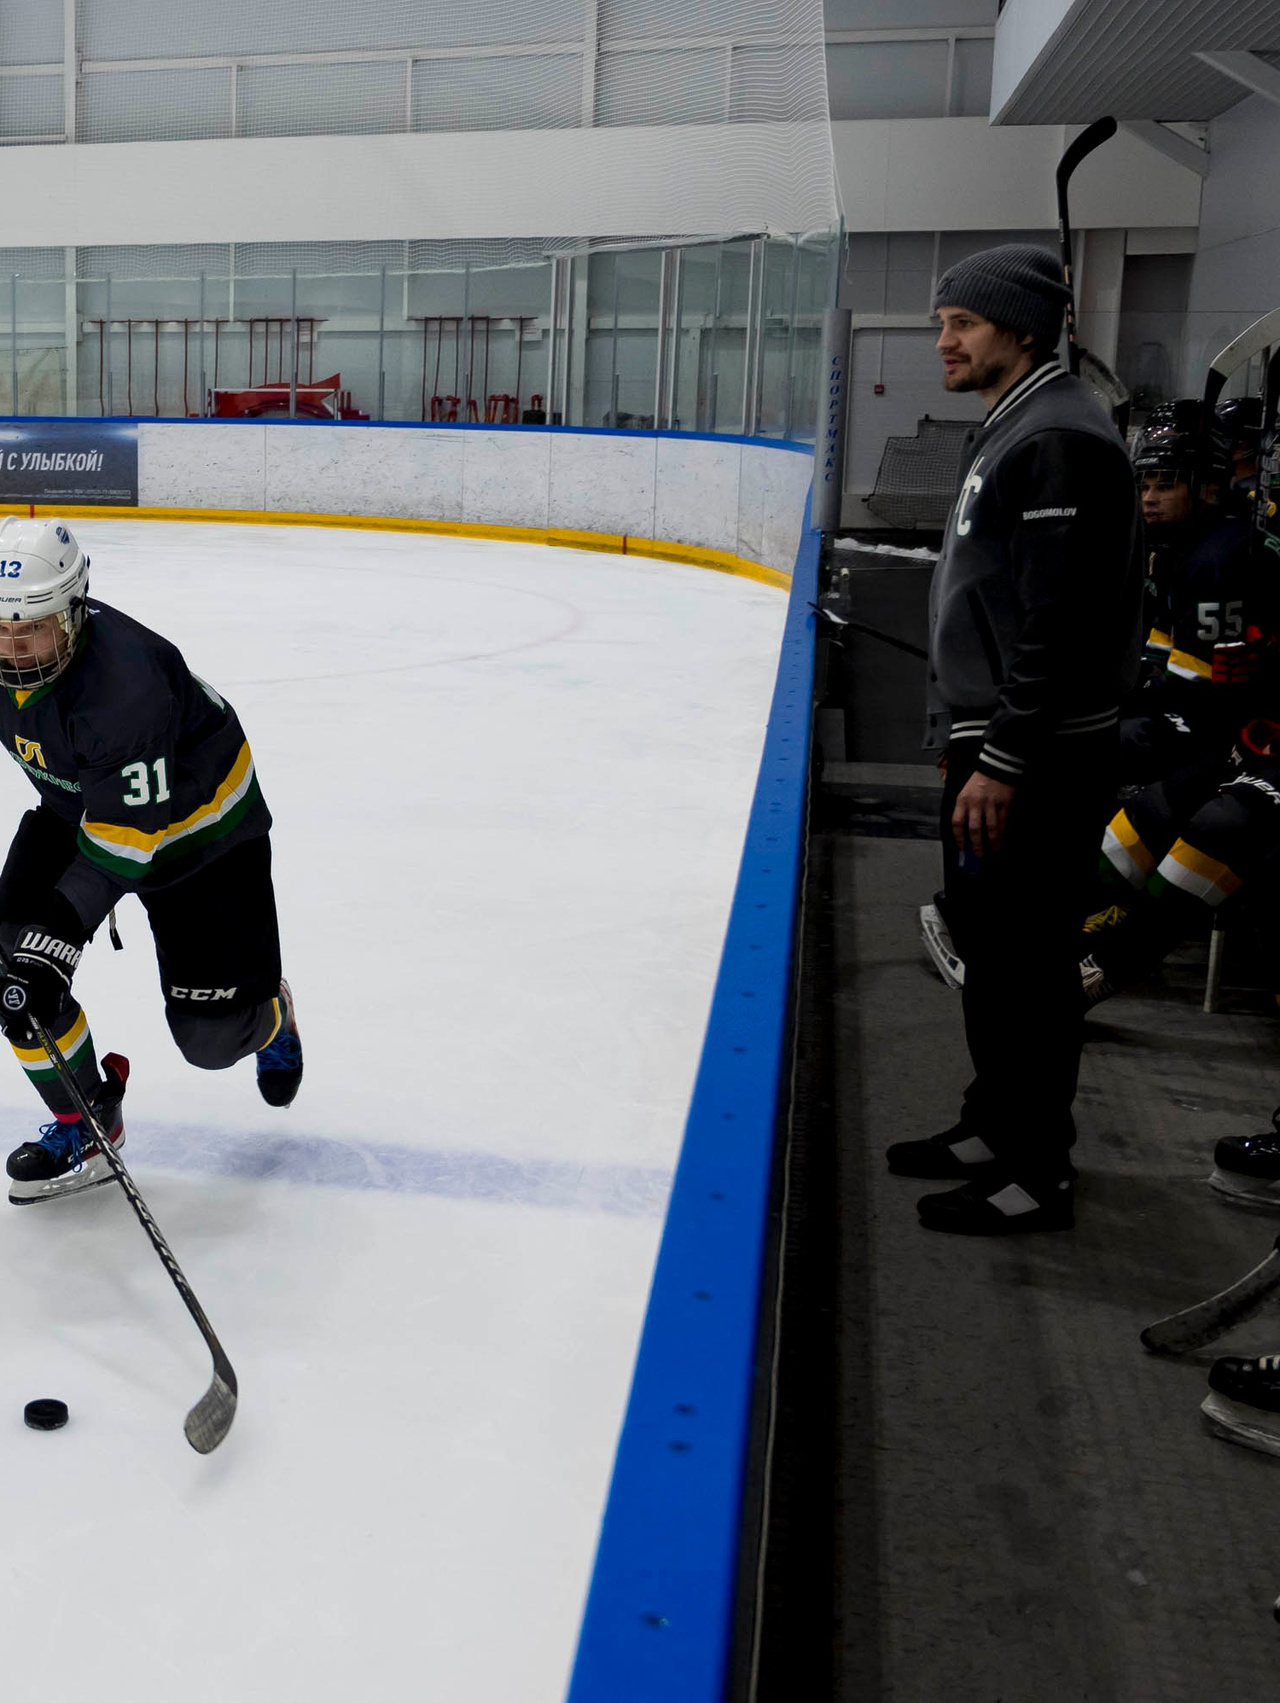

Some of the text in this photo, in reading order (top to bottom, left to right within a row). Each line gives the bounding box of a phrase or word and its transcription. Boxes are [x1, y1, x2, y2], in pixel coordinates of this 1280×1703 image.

[825, 355, 842, 483] СПОРТМАКС
[7, 453, 18, 470] С
[20, 450, 104, 472] УЛЫБКОЙ!
[1197, 600, 1243, 641] 55
[122, 757, 170, 806] 31
[171, 985, 238, 1001] CCM
